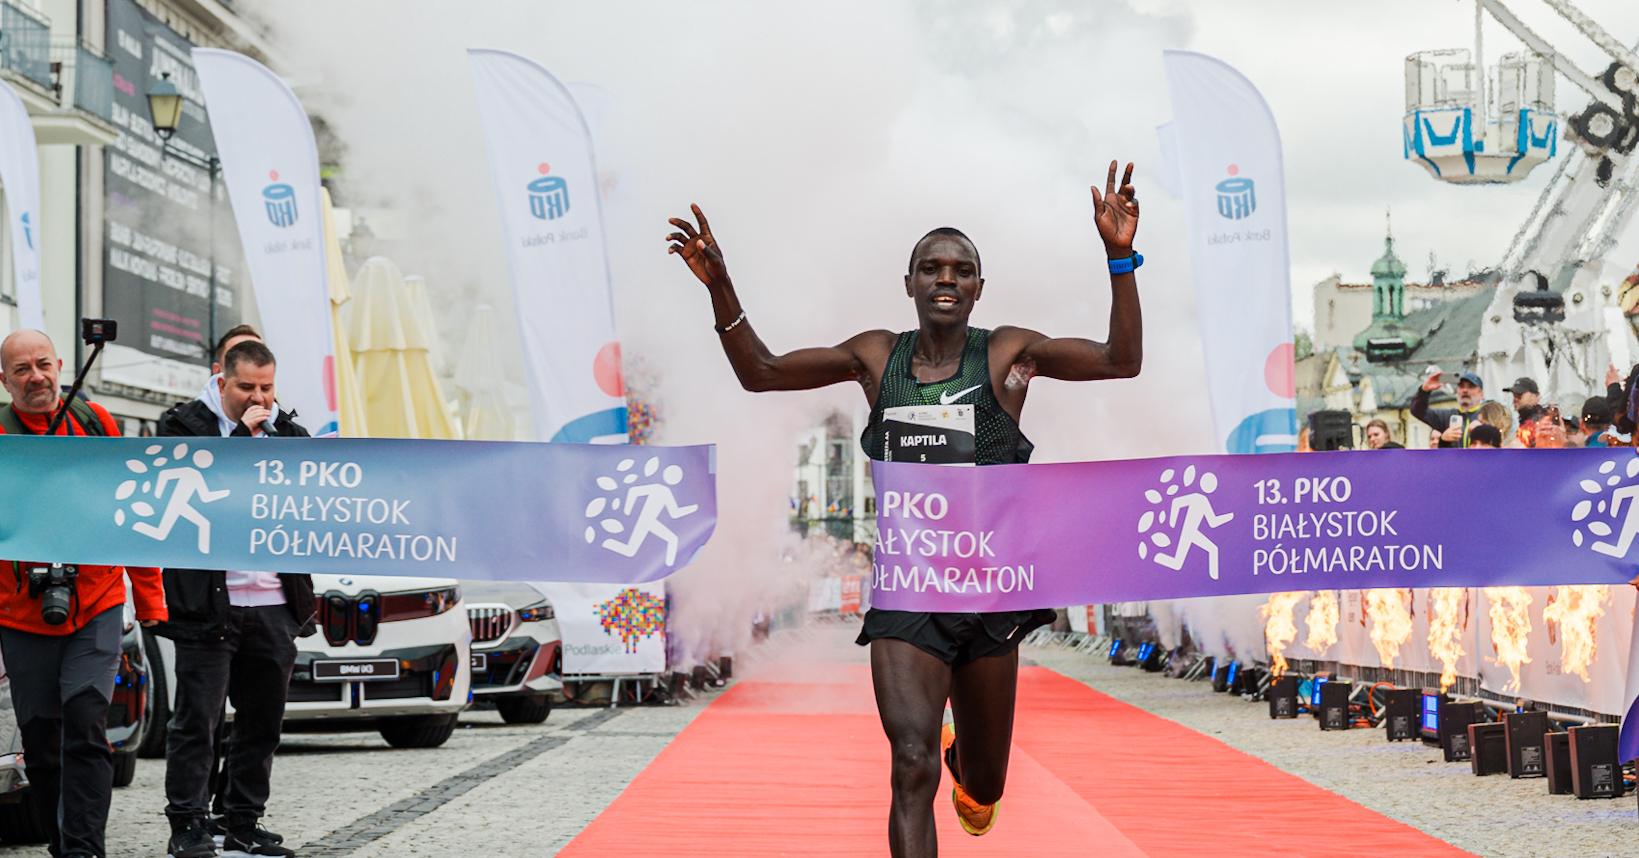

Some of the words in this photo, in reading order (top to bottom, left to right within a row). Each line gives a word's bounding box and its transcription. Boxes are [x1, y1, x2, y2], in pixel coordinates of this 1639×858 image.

[900, 434, 947, 447] KAPTILA
[920, 453, 926, 462] 5
[255, 460, 291, 485] 13.
[299, 461, 362, 488] PKO
[883, 490, 949, 520] PKO
[1254, 479, 1287, 504] 13.
[1295, 476, 1352, 503] PKO
[251, 493, 410, 525] BIAŁYSTOK
[1253, 510, 1398, 540] BIAŁYSTOK
[249, 525, 457, 562] PÓŁMARATON
[875, 528, 995, 558] AŁYSTOK
[1253, 543, 1443, 575] PÓŁMARATON
[872, 559, 1034, 593] ÓŁMARATON
[340, 664, 360, 674] BMW
